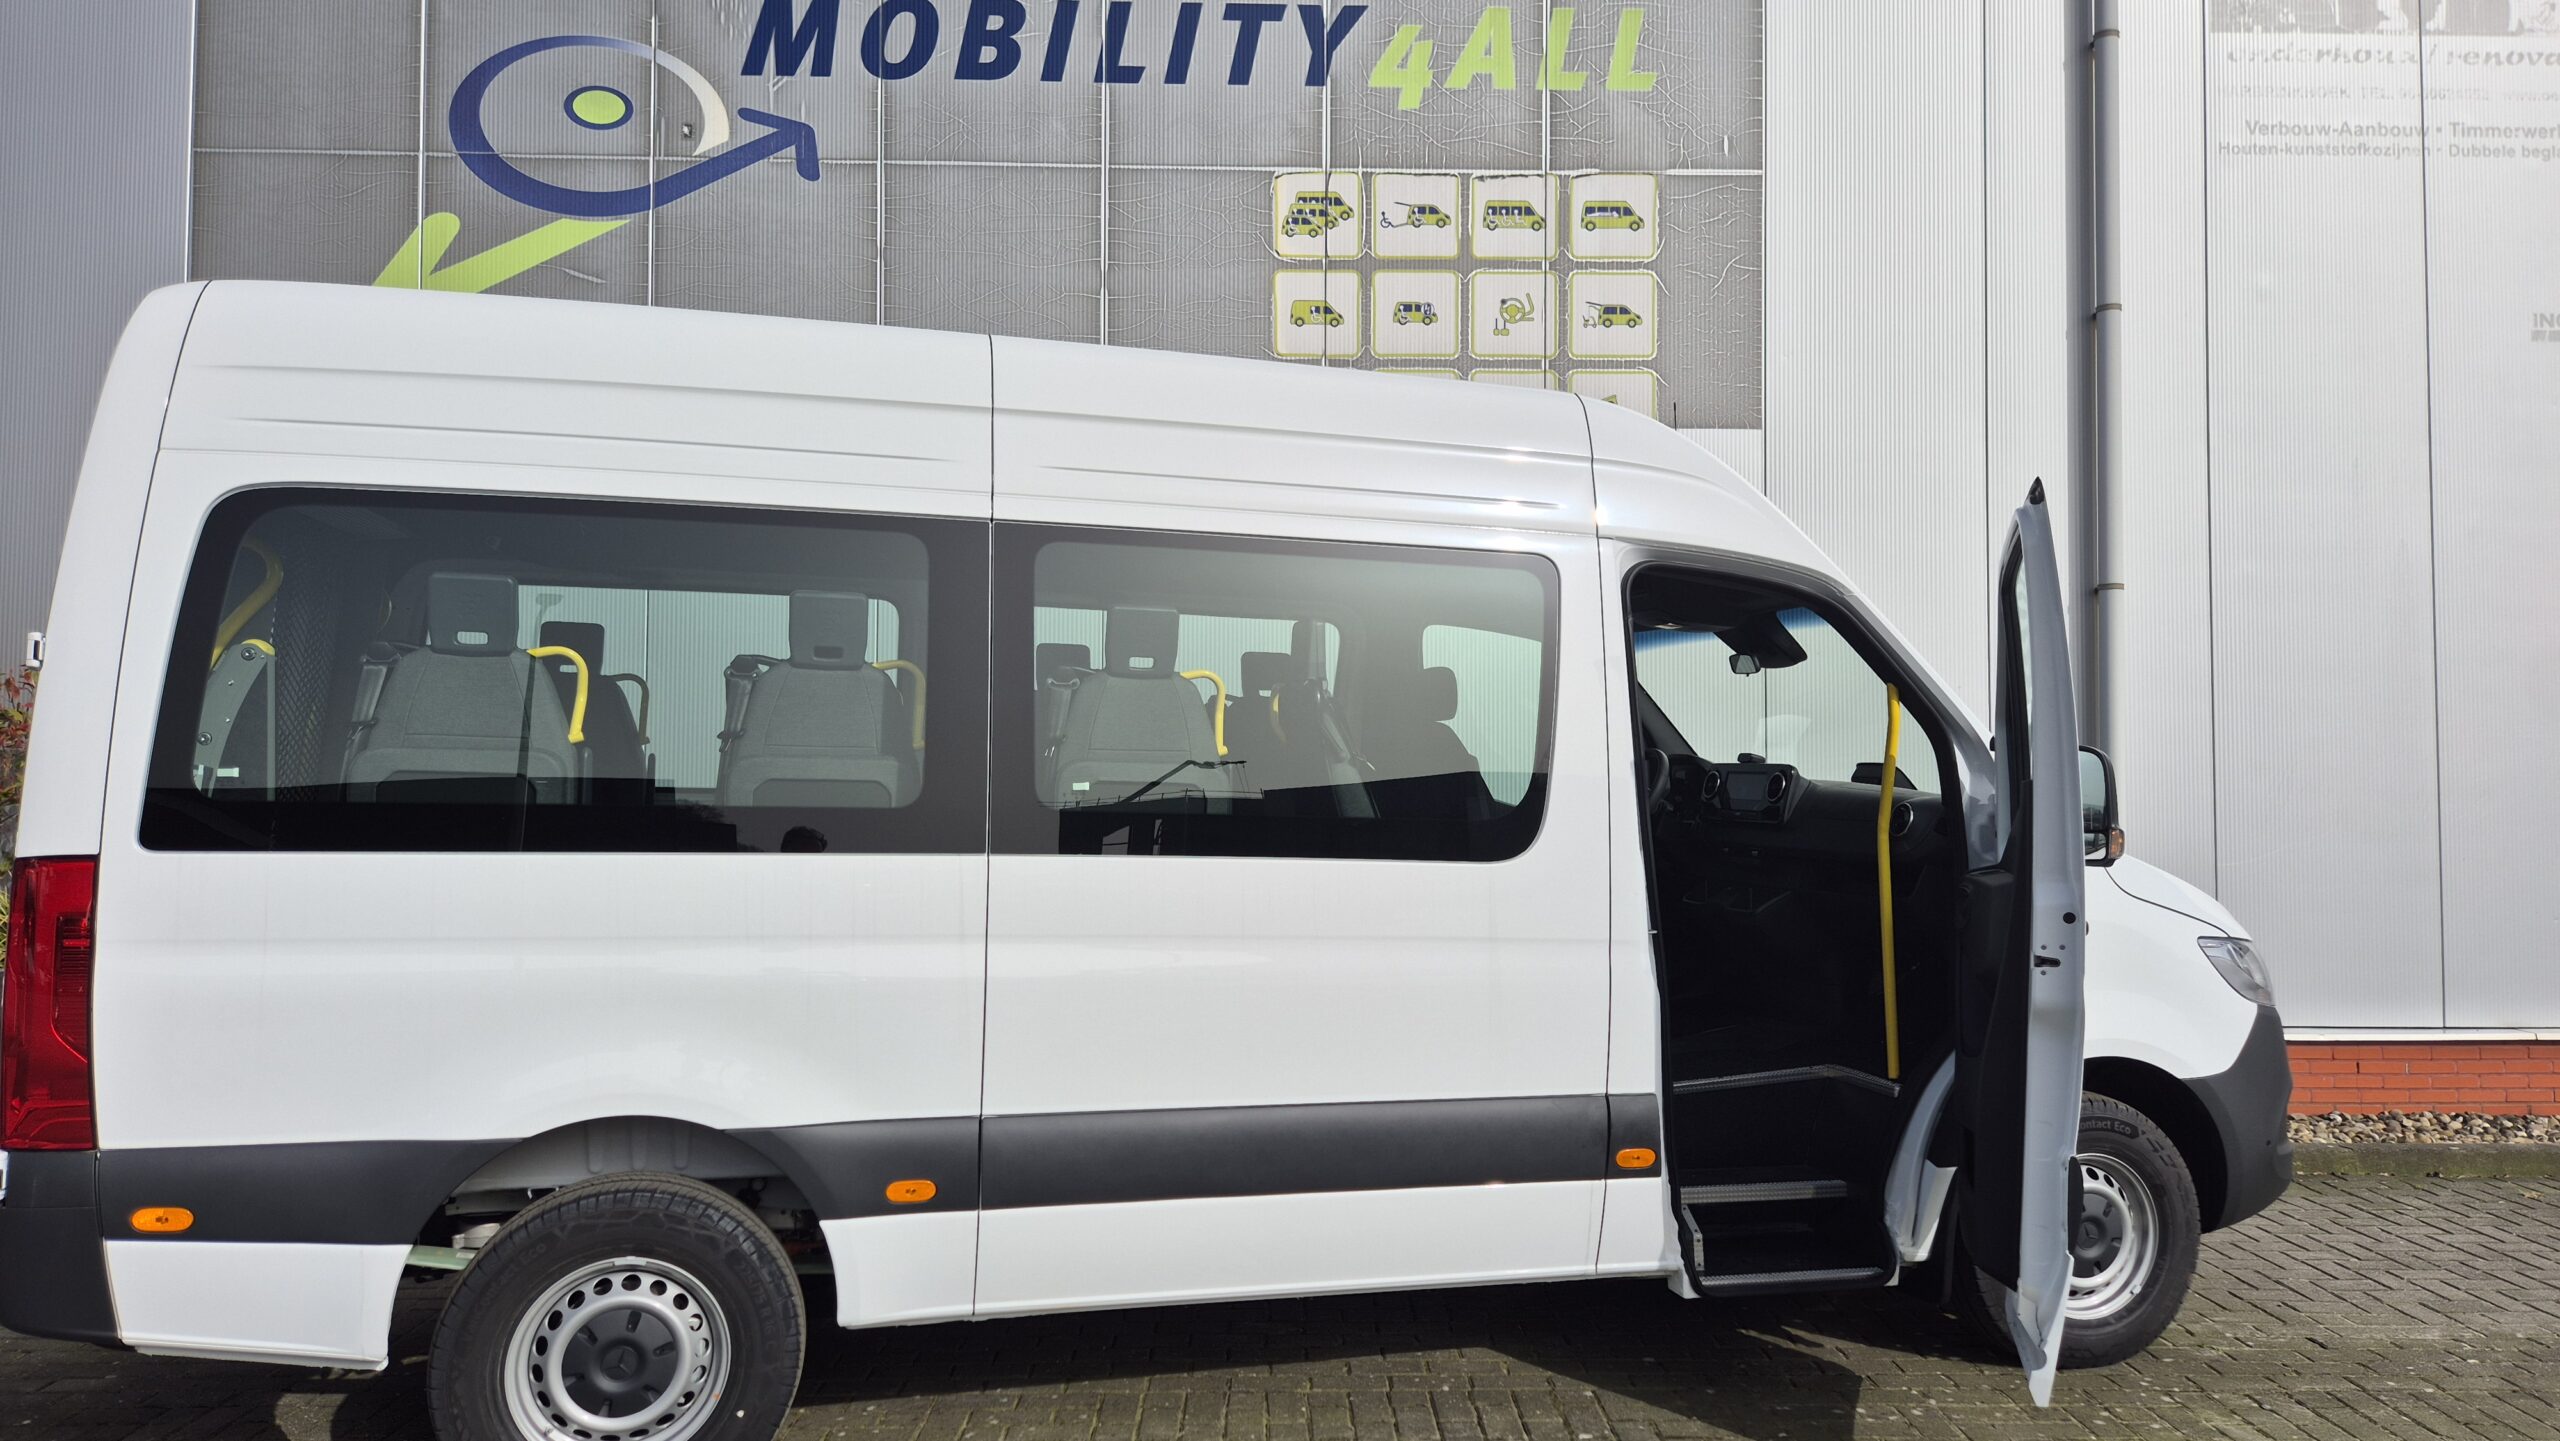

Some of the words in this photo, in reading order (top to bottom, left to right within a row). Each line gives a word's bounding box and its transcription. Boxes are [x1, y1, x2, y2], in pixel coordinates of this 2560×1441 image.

[2245, 120, 2431, 138] Verbouw-Aanbouw
[2449, 144, 2516, 158] Dubbele
[2080, 1119, 2111, 1130] ontact
[2114, 1121, 2131, 1135] Eco
